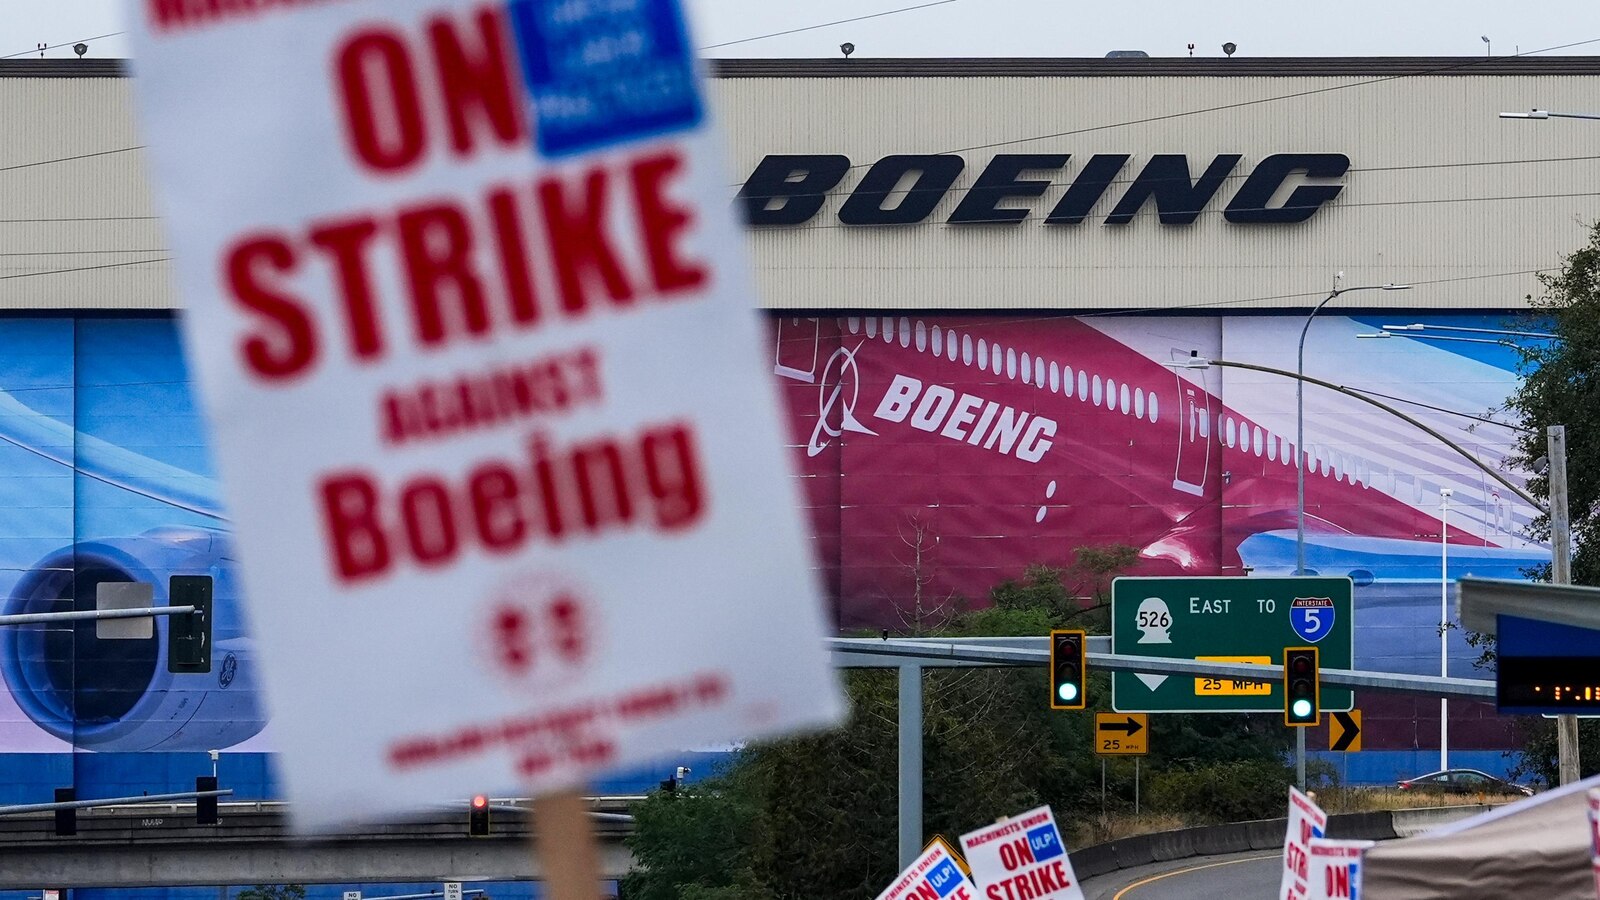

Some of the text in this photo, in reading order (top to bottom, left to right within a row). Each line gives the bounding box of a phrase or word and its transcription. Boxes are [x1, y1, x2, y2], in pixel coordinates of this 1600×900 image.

[331, 4, 526, 176] ON
[729, 154, 1350, 225] BOEING
[222, 148, 710, 382] STRIKE
[873, 374, 1057, 463] BOEING
[318, 418, 708, 586] Boeing
[1139, 612, 1169, 628] 526
[1257, 600, 1275, 613] TO
[1304, 609, 1321, 633] 5
[1203, 679, 1263, 690] 25 MPH
[1103, 740, 1120, 750] 25
[966, 812, 1048, 849] MACHINISTS UNION
[1031, 831, 1057, 850] ULP!
[999, 837, 1035, 871] ON
[884, 868, 919, 900] CHINISTS
[918, 848, 942, 873] UNION
[931, 864, 956, 888] ULP!
[986, 861, 1070, 900] STRIKE
[1324, 865, 1349, 898] ON
